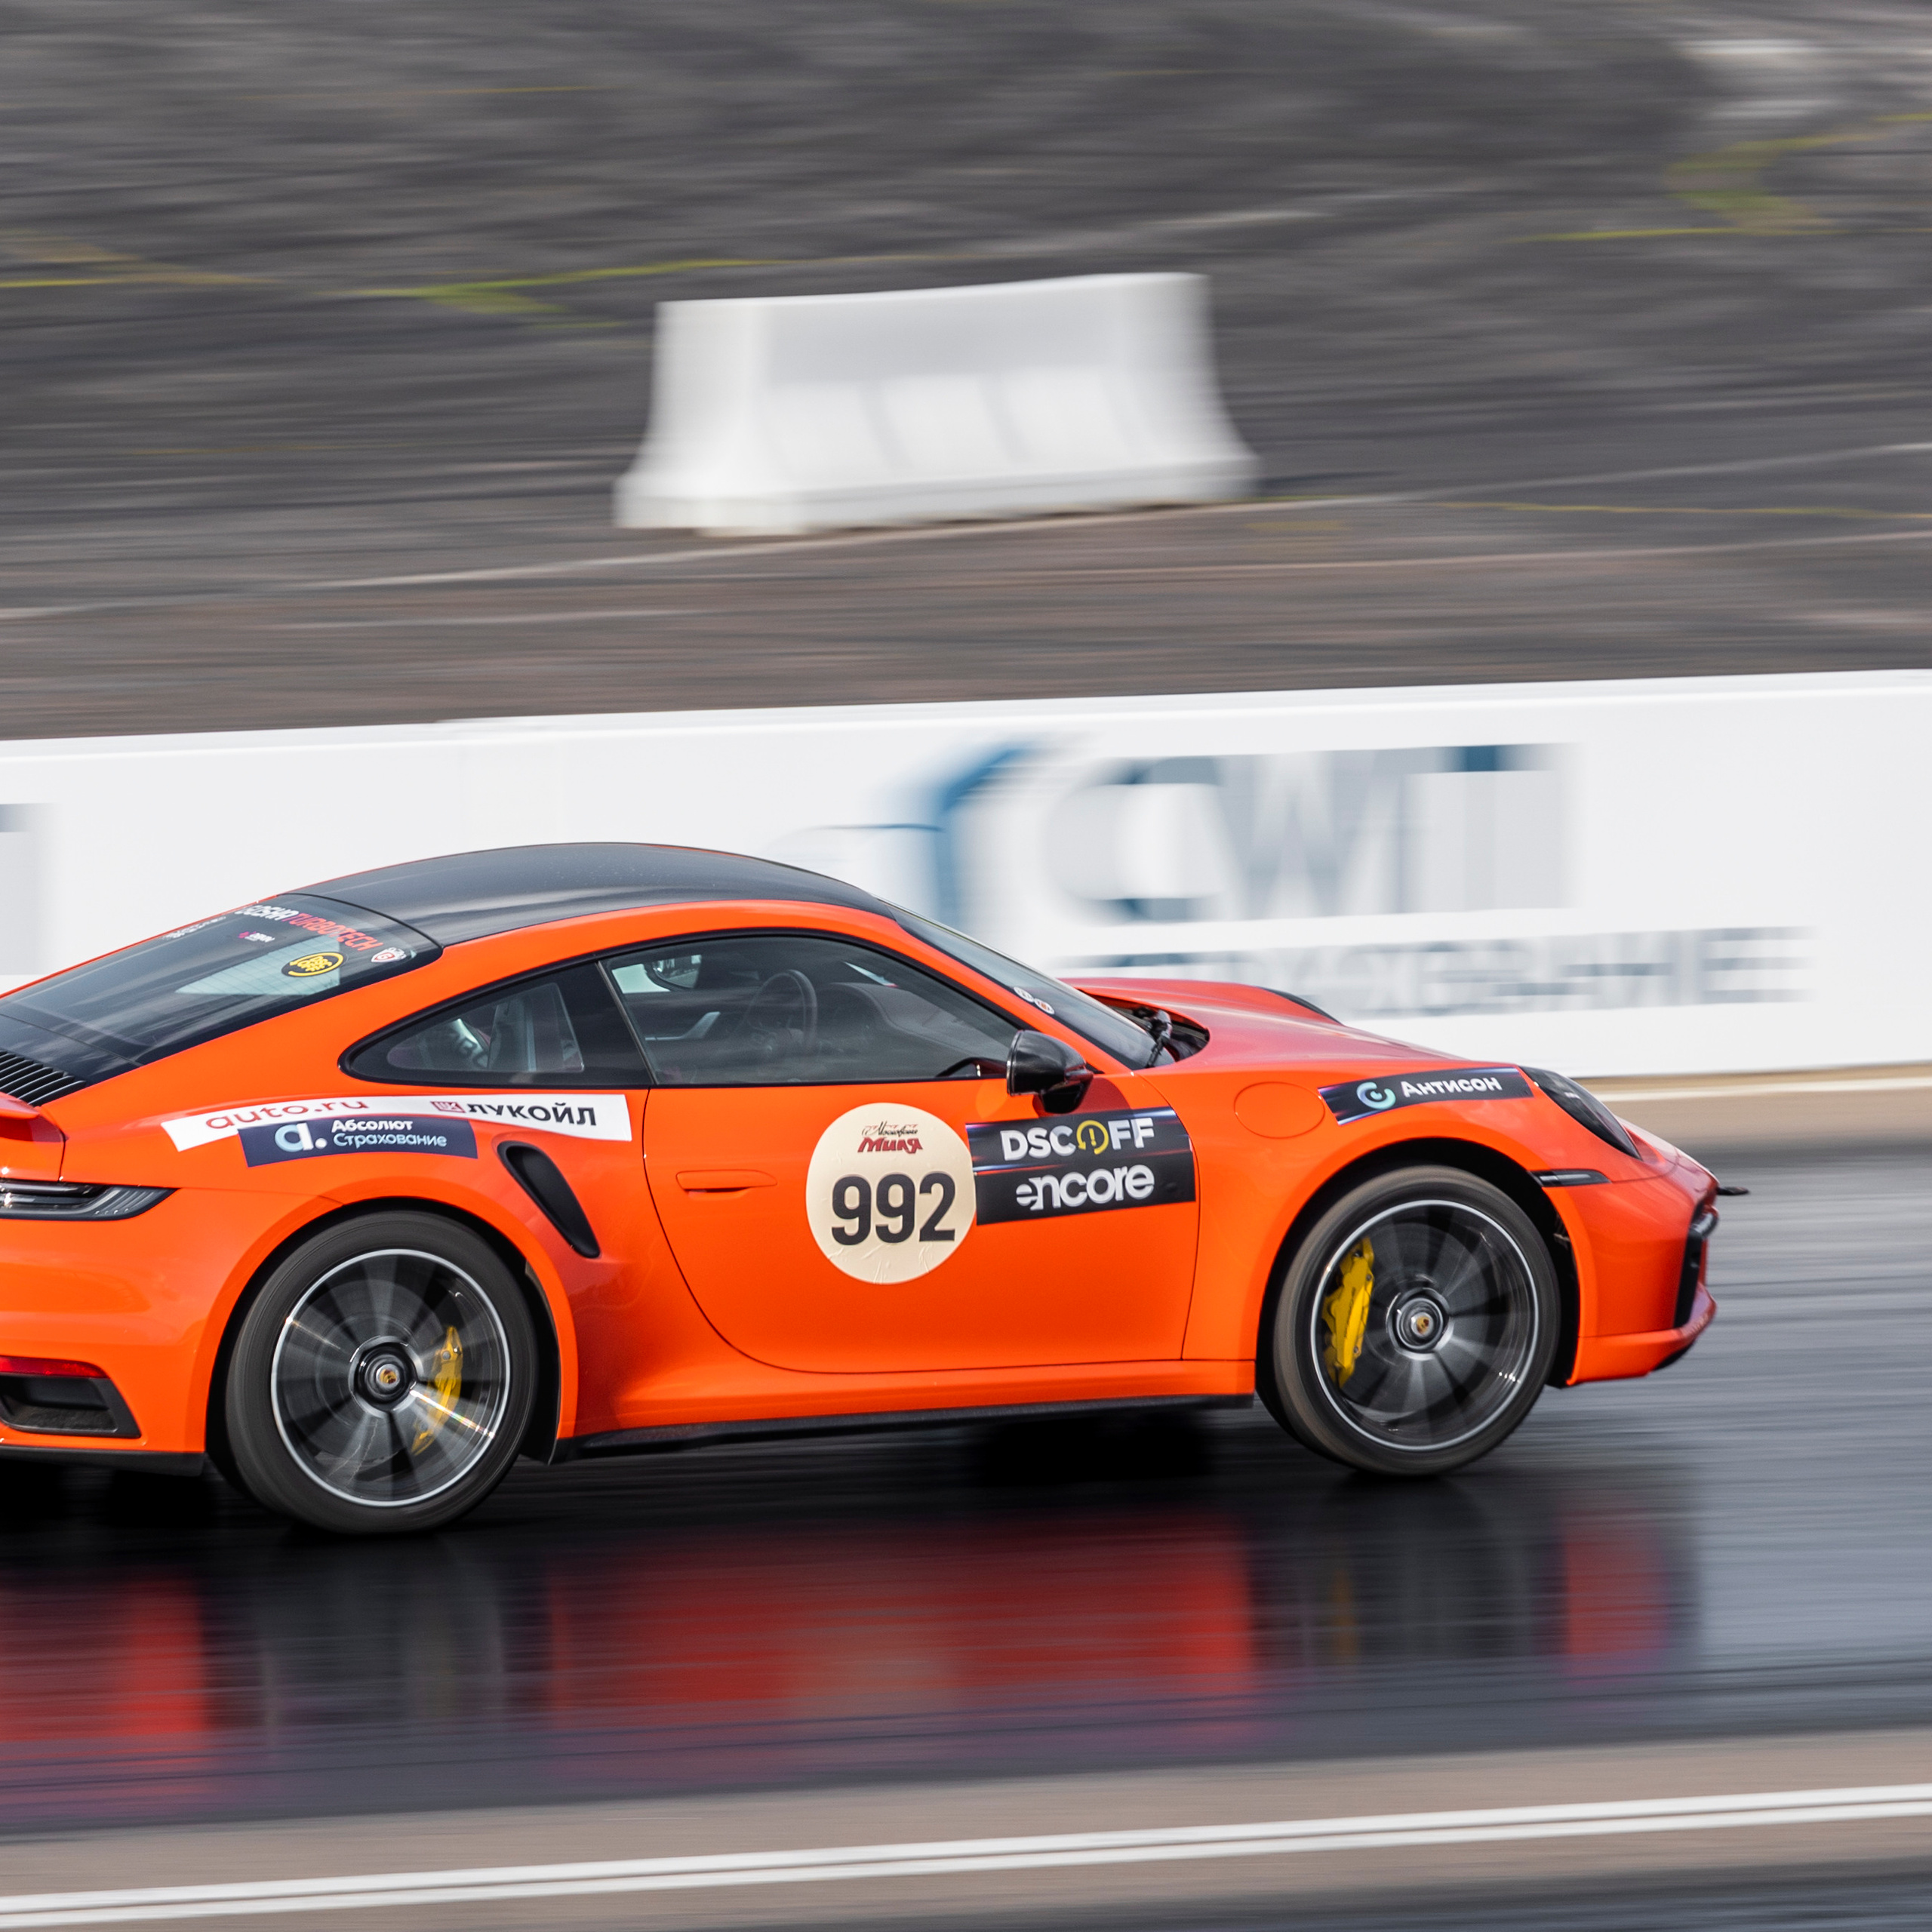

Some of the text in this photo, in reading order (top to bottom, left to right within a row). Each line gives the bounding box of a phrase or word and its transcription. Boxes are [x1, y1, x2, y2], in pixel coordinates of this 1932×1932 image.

[205, 1100, 369, 1129] auto.ru
[331, 1118, 414, 1133] Абсолют
[466, 1102, 597, 1127] ЛУКОЙЛ
[333, 1132, 448, 1149] Страхование
[1016, 1164, 1155, 1211] encore
[831, 1171, 956, 1246] 992
